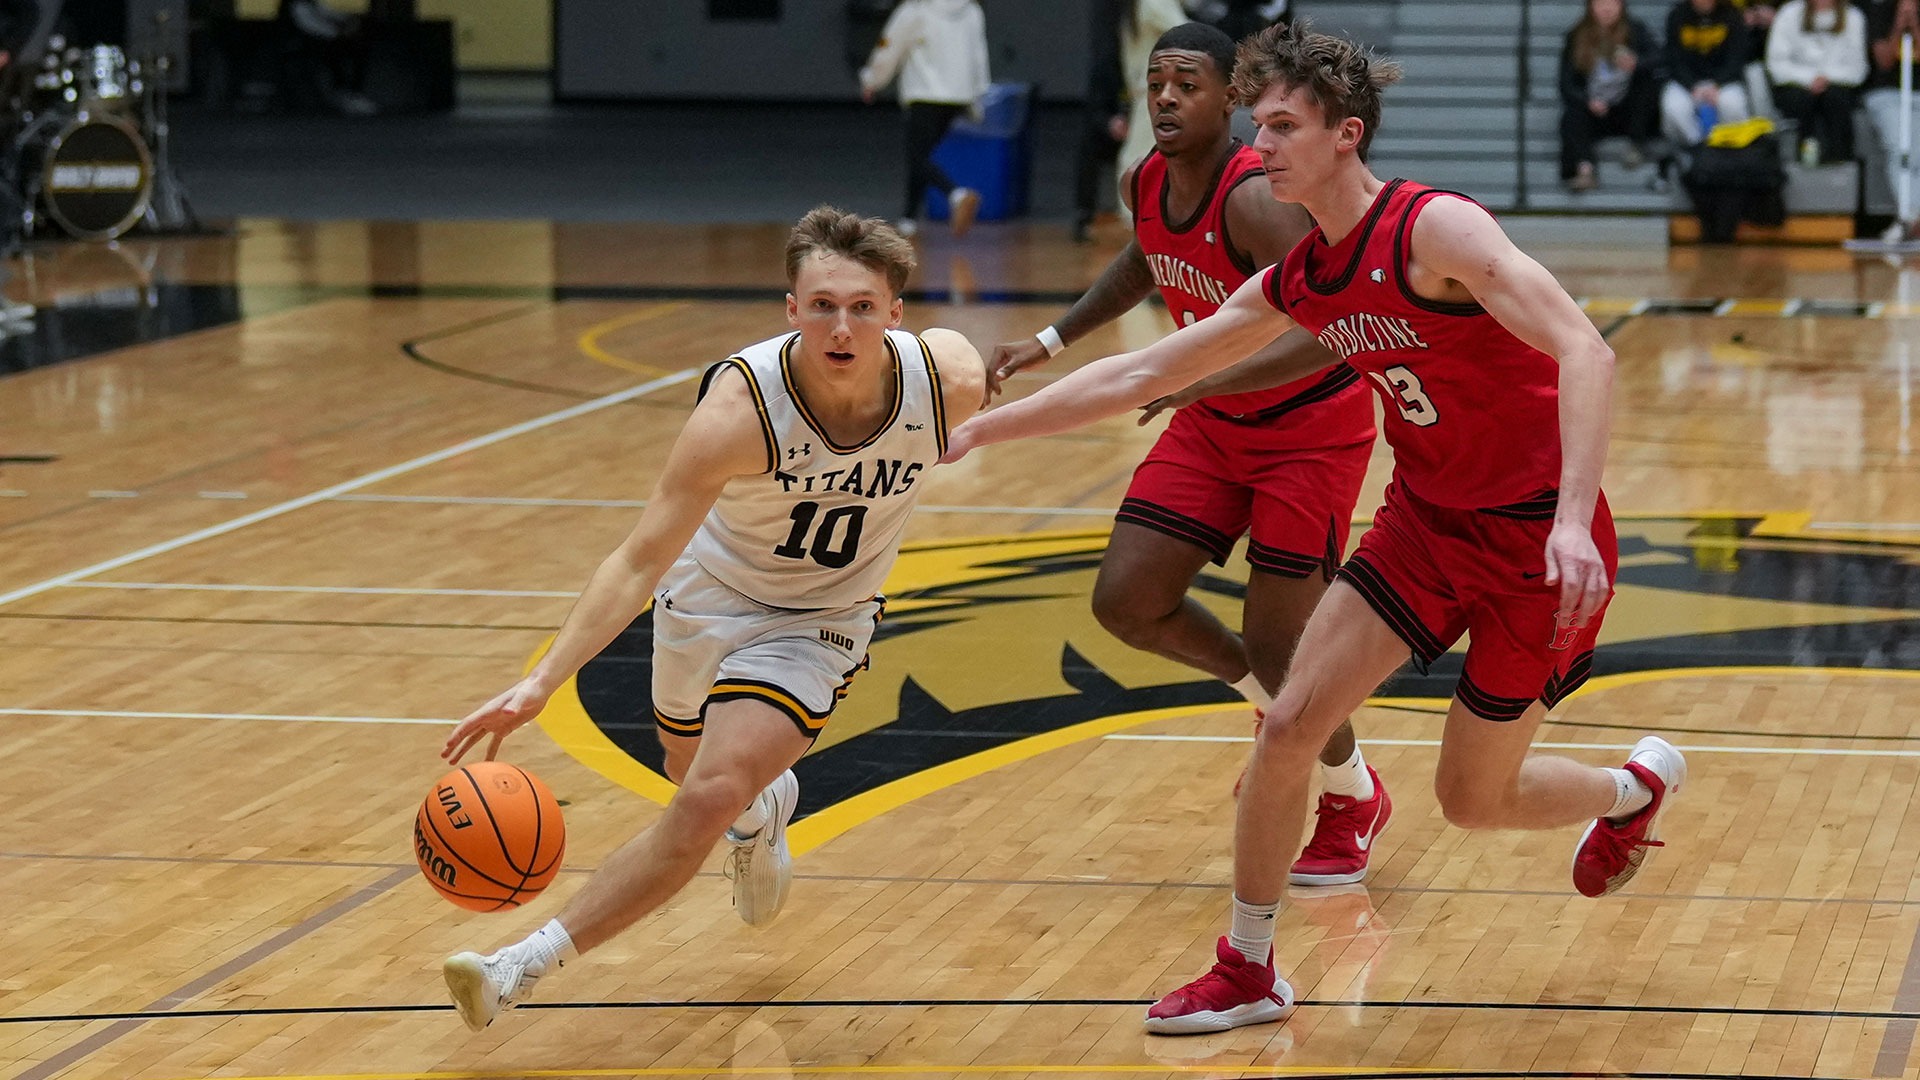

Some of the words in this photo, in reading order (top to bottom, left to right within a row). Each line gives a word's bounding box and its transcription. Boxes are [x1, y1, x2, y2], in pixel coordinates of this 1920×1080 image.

[774, 458, 924, 499] TITANS
[773, 501, 869, 569] 10
[819, 629, 854, 651] UWO
[438, 785, 474, 830] EVO
